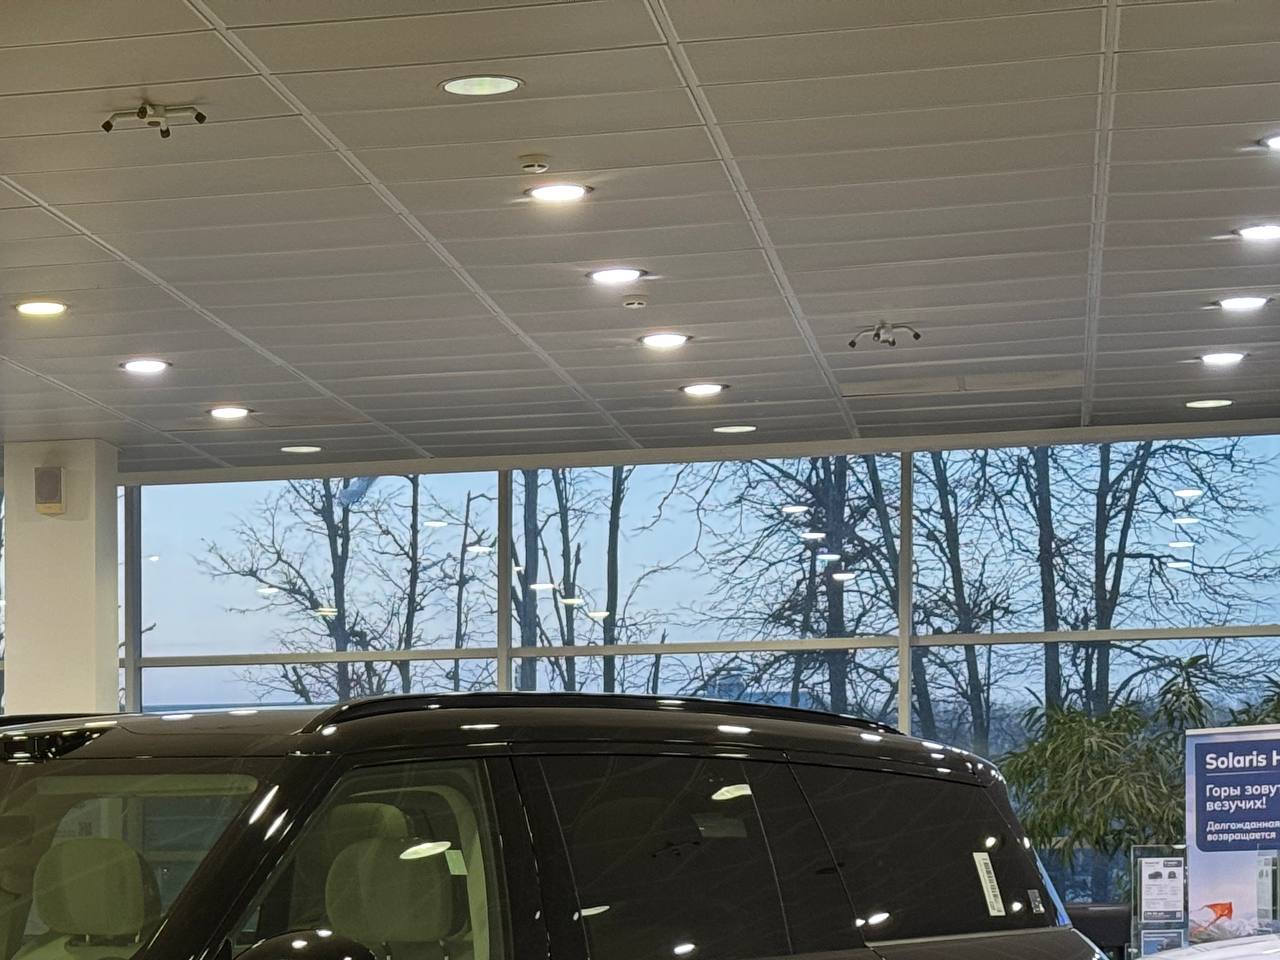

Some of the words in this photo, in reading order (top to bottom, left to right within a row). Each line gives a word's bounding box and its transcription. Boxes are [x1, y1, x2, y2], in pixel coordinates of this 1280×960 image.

[1205, 751, 1267, 769] Solaris
[1206, 784, 1241, 799] Горы
[1206, 796, 1266, 813] везучих!
[1206, 832, 1276, 842] возвращается
